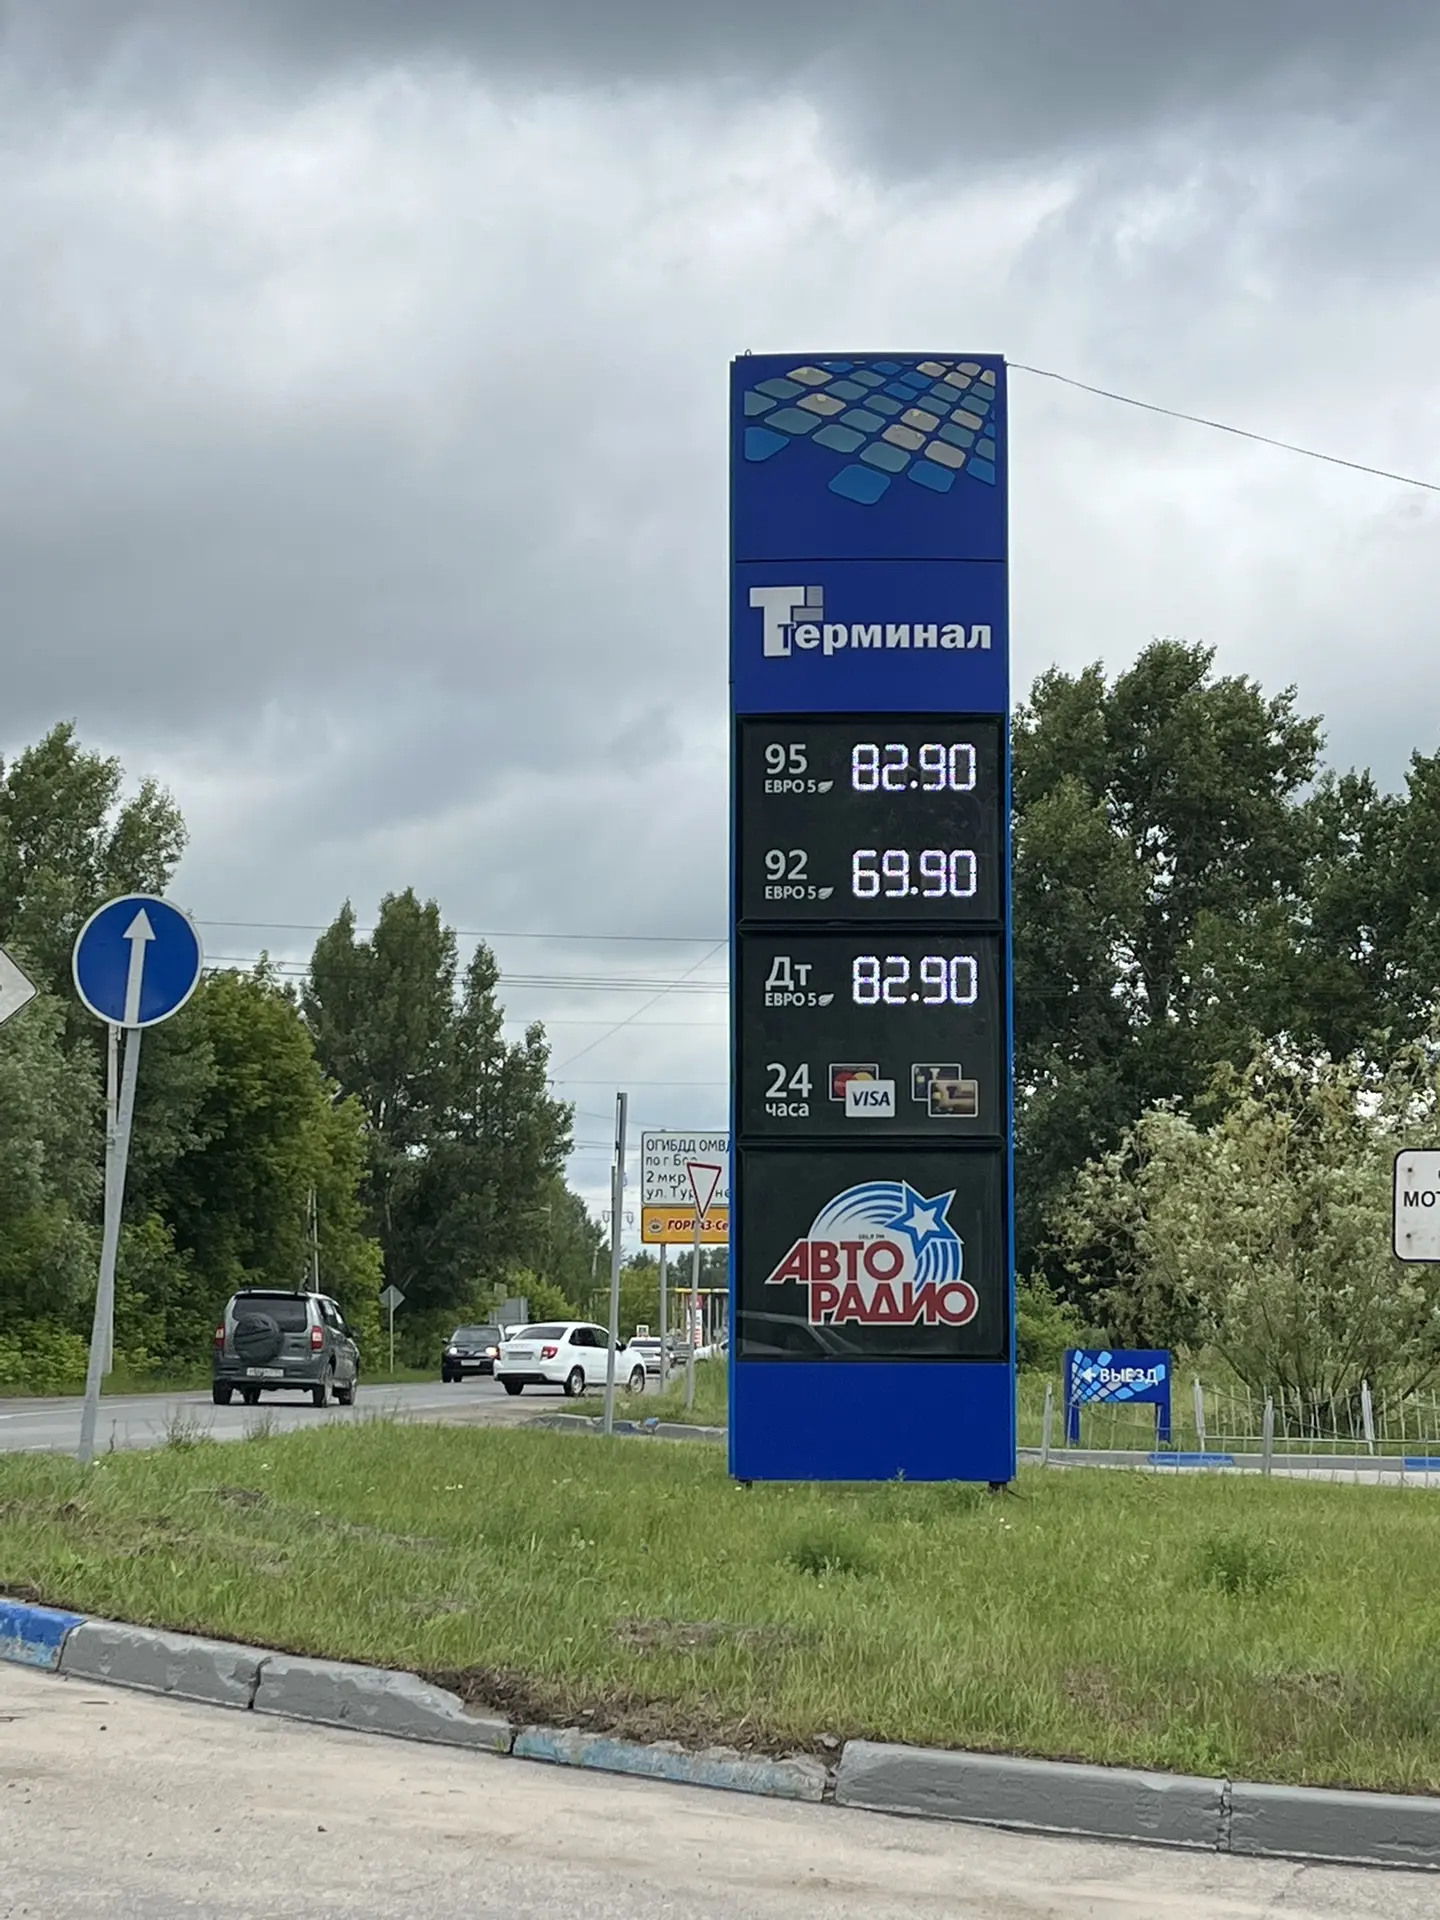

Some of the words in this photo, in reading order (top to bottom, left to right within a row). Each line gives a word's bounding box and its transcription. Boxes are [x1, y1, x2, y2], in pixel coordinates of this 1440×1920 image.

[750, 585, 991, 656] Терминал
[765, 744, 808, 775] 95
[852, 743, 977, 791] 82.90
[764, 780, 805, 793] ЕВРО
[806, 780, 817, 793] 5
[765, 850, 808, 881] 92
[852, 849, 977, 897] 69.90
[764, 886, 805, 899] ЕВРО
[806, 886, 817, 899] 5
[765, 956, 812, 991] Дт
[852, 956, 978, 1004] 82.90
[764, 993, 805, 1007] ЕВРО
[807, 993, 817, 1007] 5
[765, 1063, 813, 1098] 24
[852, 1090, 891, 1106] VISA
[765, 1103, 810, 1117] часа
[646, 1138, 697, 1153] ОГИБДД
[646, 1170, 655, 1183] 2
[767, 1240, 905, 1282] АВТО
[809, 1282, 978, 1324] РАДИО
[1100, 1367, 1159, 1387] ВЫЕЗД
